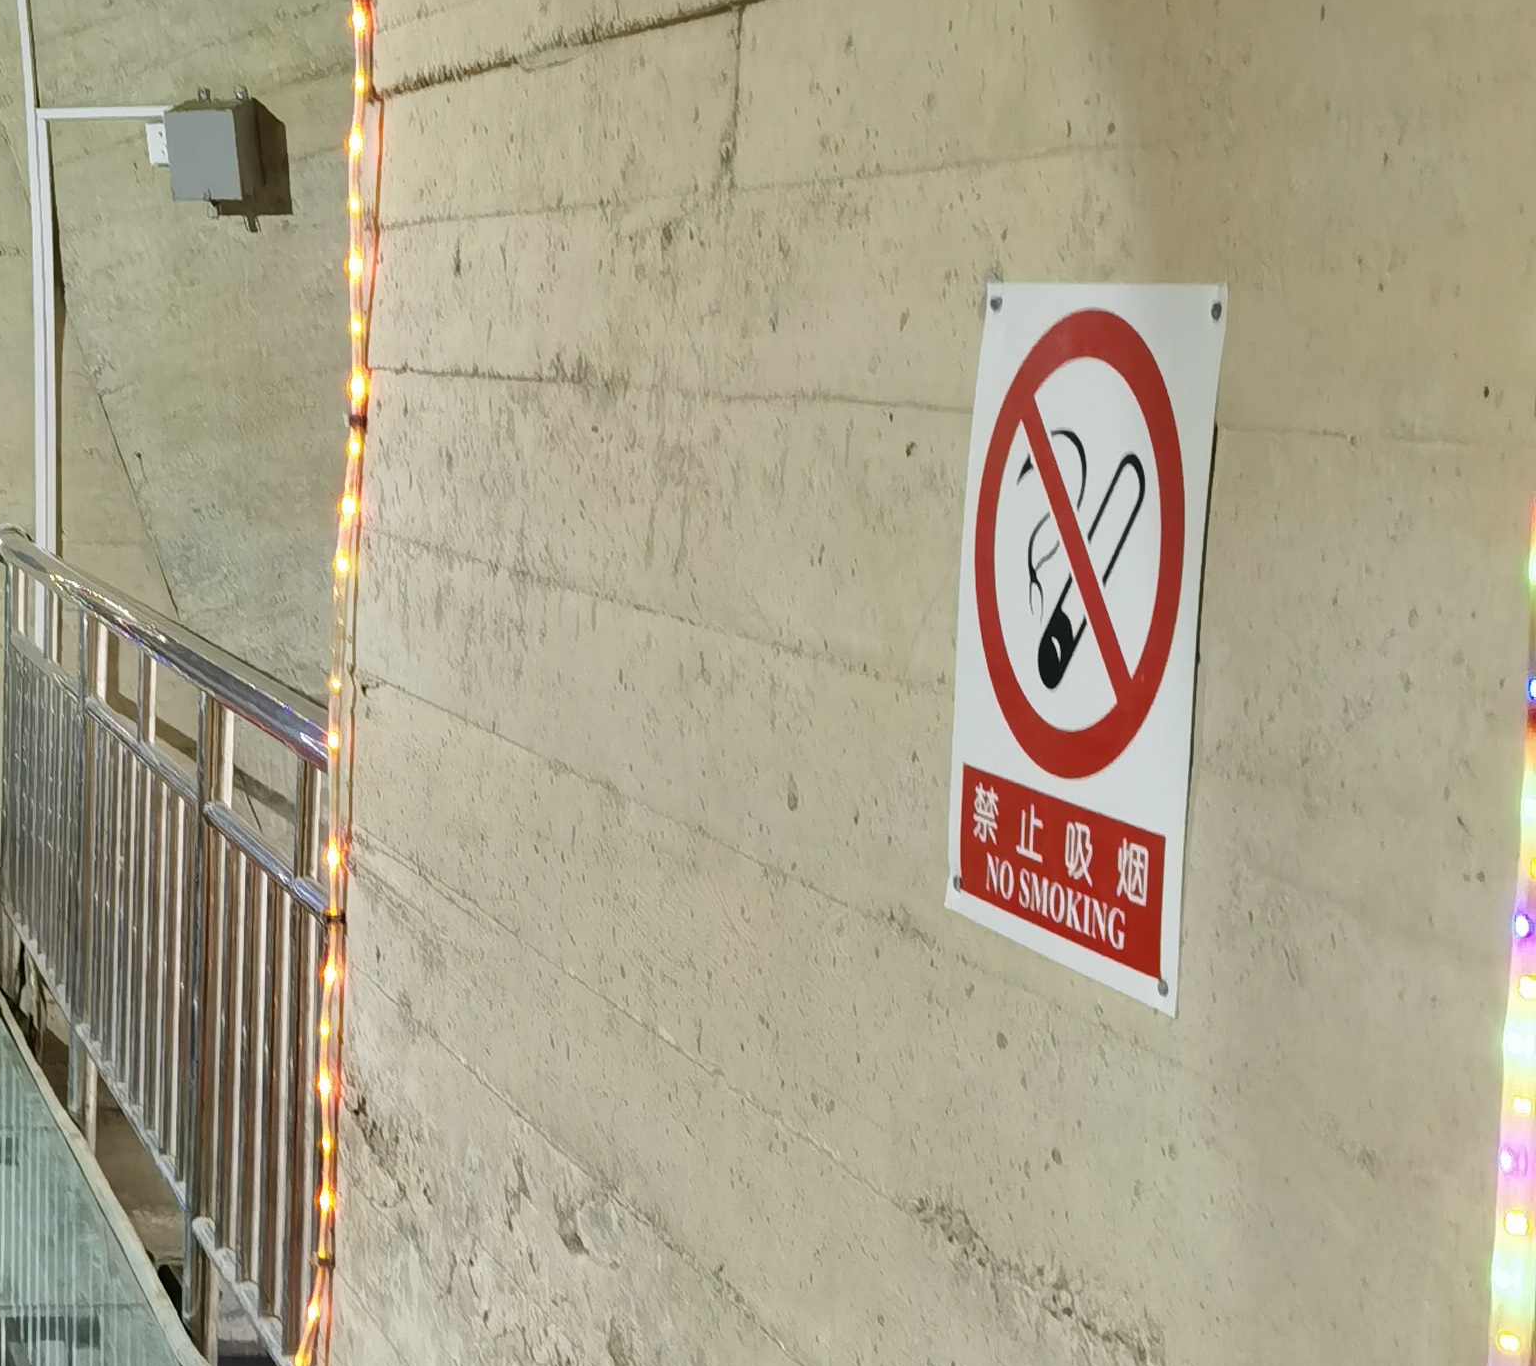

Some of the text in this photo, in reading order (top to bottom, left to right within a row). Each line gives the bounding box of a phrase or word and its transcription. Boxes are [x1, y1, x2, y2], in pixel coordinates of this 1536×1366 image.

[973, 782, 1149, 907] 禁止吸烟
[986, 852, 1126, 951] NO SMOKING
